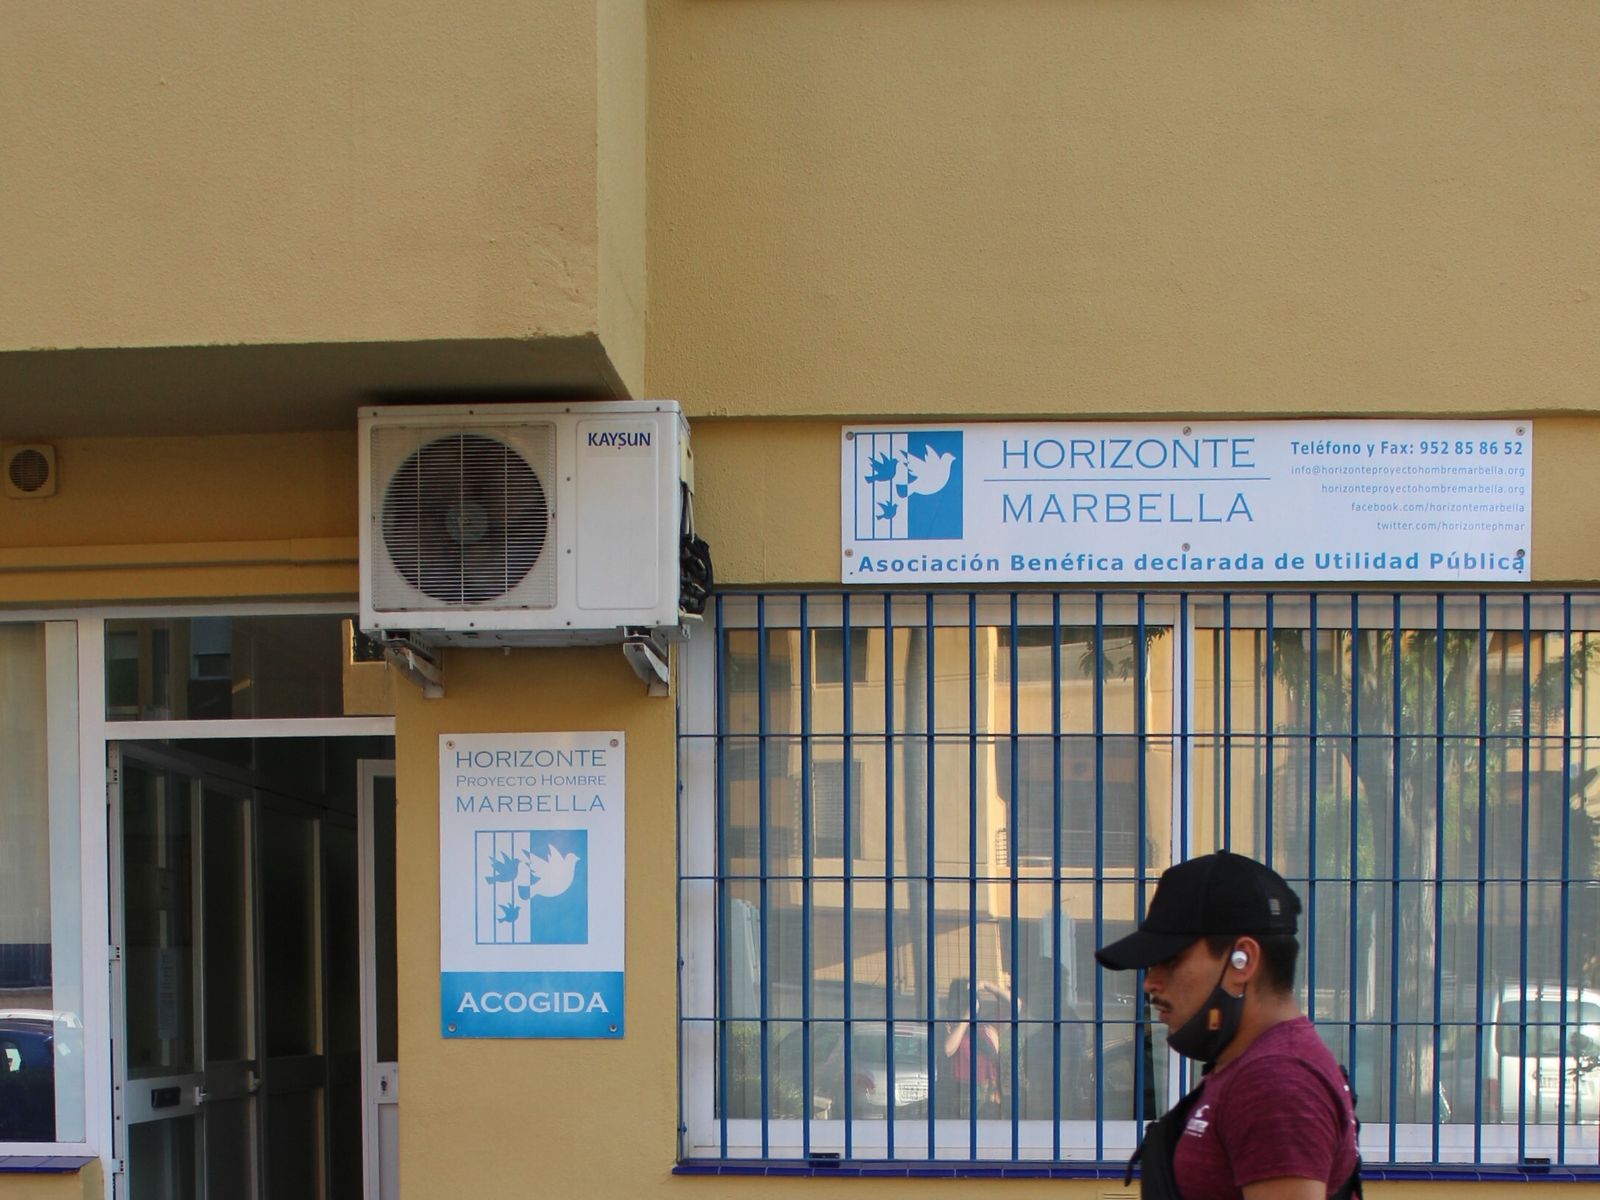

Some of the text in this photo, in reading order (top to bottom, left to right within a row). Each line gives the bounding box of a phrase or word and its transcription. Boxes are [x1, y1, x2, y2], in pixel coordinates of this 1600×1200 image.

[588, 432, 651, 447] KAYSUN
[1002, 438, 1256, 469] HORIZONTE
[1291, 440, 1523, 458] Teléfono y Fax: 952 85 86 52
[1291, 465, 1525, 477] info@horizonteproyectohombremarbella.org
[1321, 484, 1525, 496] horizonteproyectohombremarbella.org
[1002, 492, 1254, 523] MARBELLA
[1351, 502, 1525, 513] facebook.com/horizontemarbella
[1376, 521, 1525, 532] twitter.com/horizontephmar
[858, 551, 1525, 573] Asociación Benéfica declarada de Utilidad Pública
[456, 749, 606, 769] HORIZONTE
[456, 794, 606, 813] MARBELLA
[457, 991, 609, 1013] ACOGIDA
